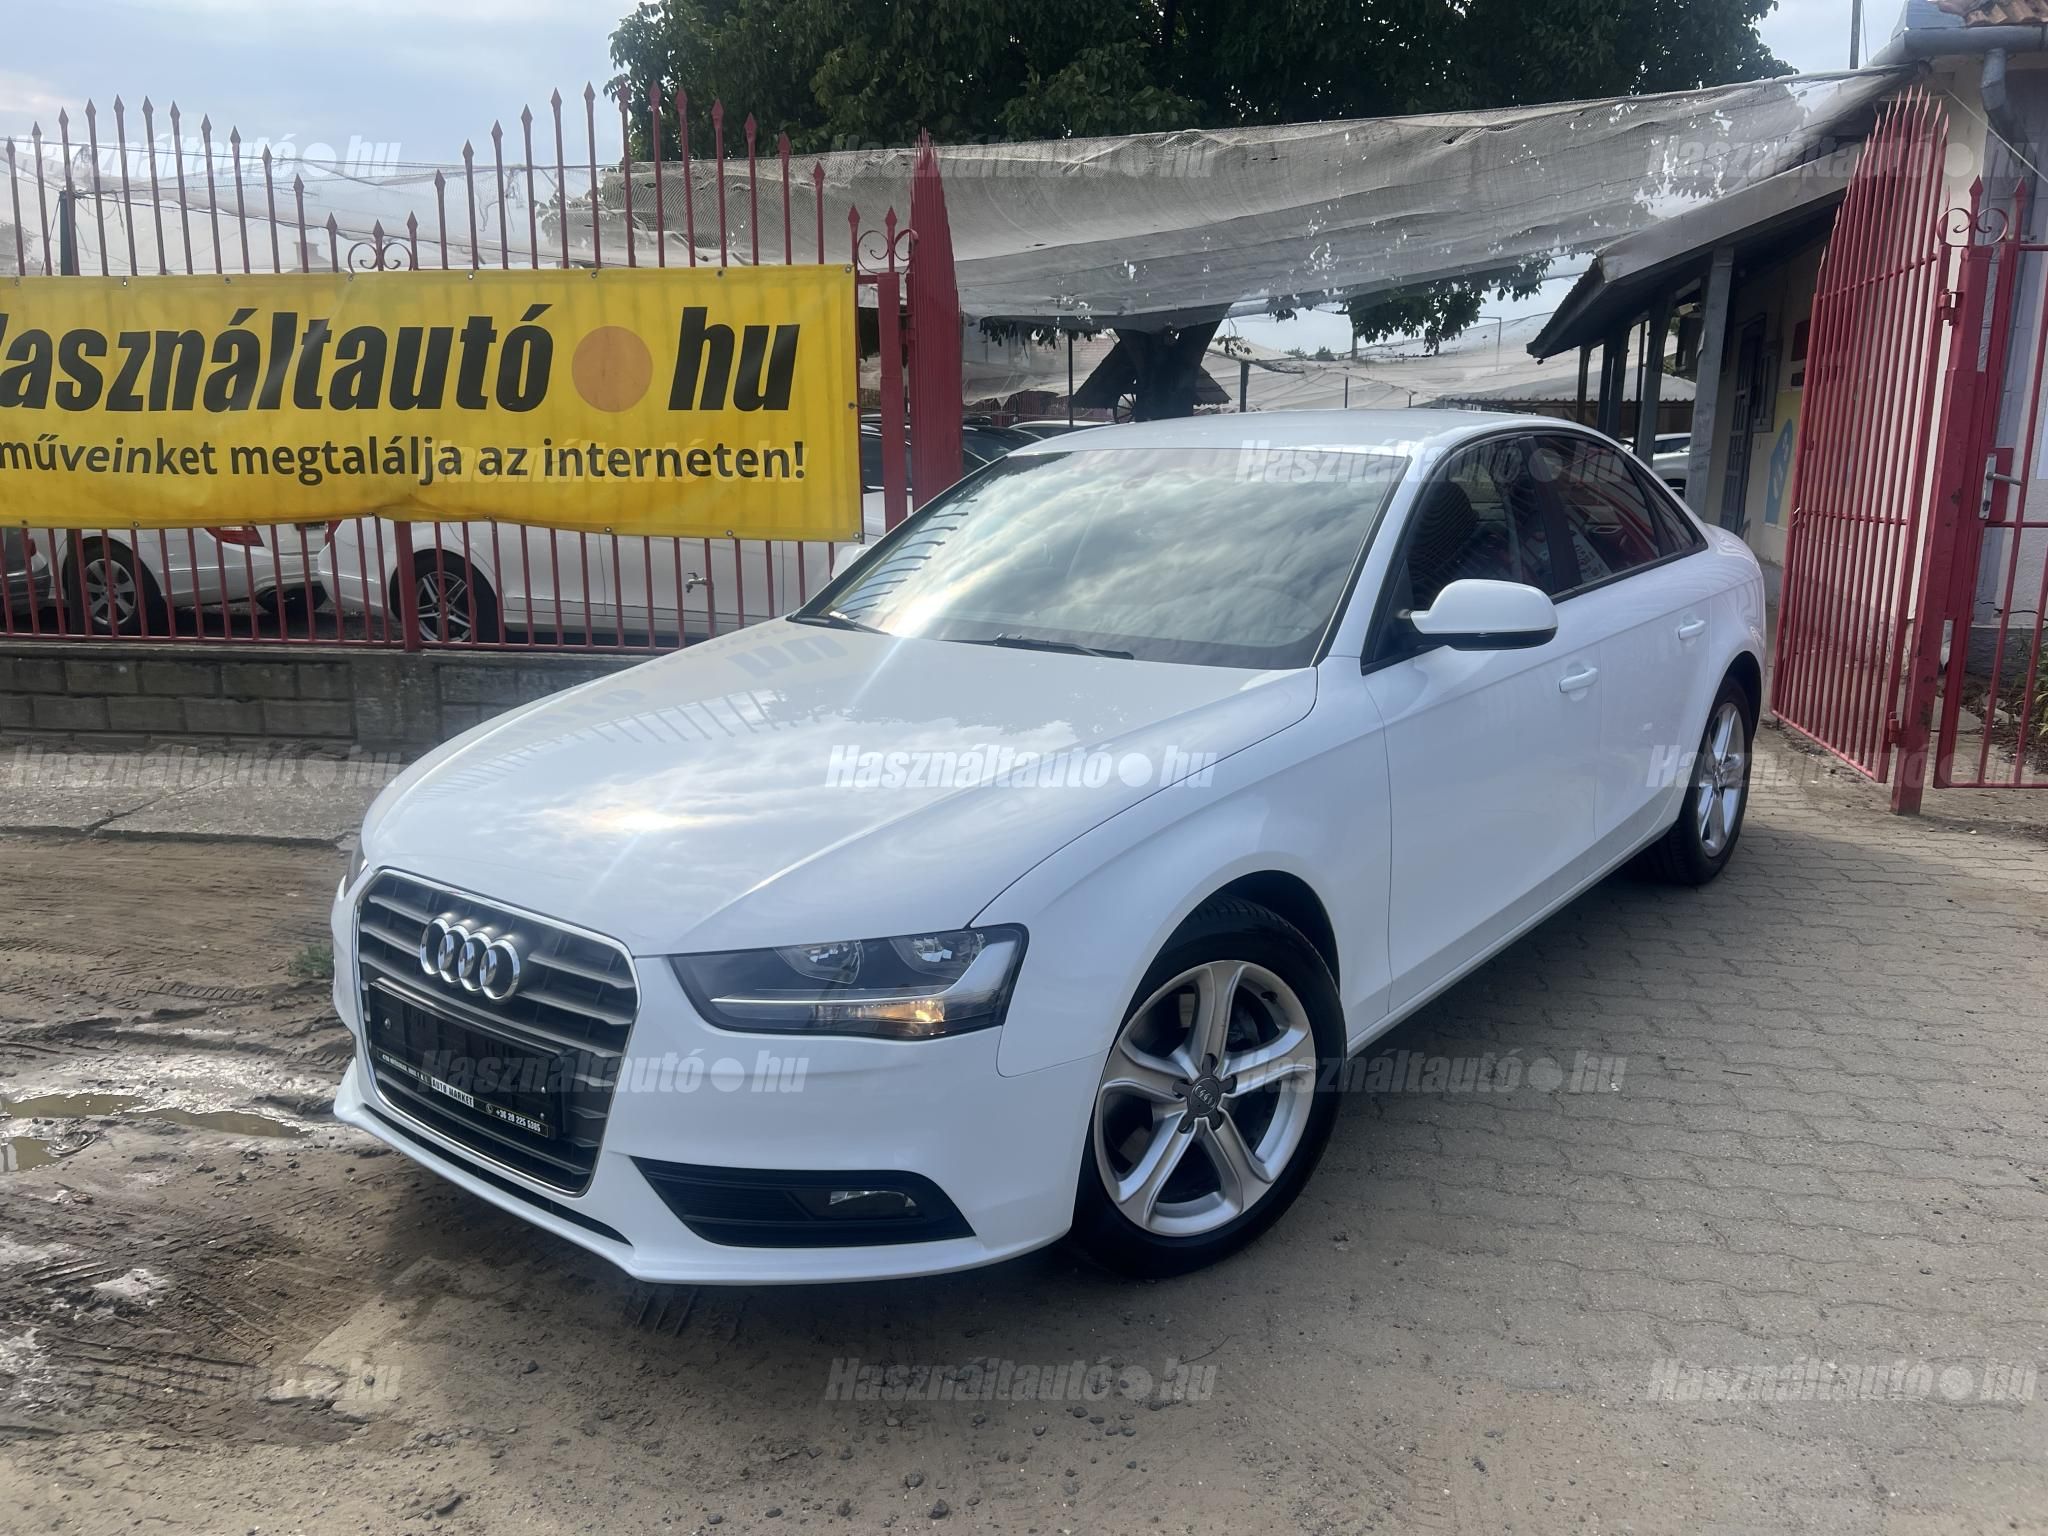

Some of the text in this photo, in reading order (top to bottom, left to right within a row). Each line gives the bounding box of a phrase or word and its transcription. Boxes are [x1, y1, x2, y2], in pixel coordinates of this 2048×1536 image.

[0, 304, 553, 413] asználtautó
[230, 436, 462, 486] megtalálja
[478, 446, 528, 476] az
[544, 438, 805, 480] interneten!
[432, 1077, 474, 1106] AUTO MARKET
